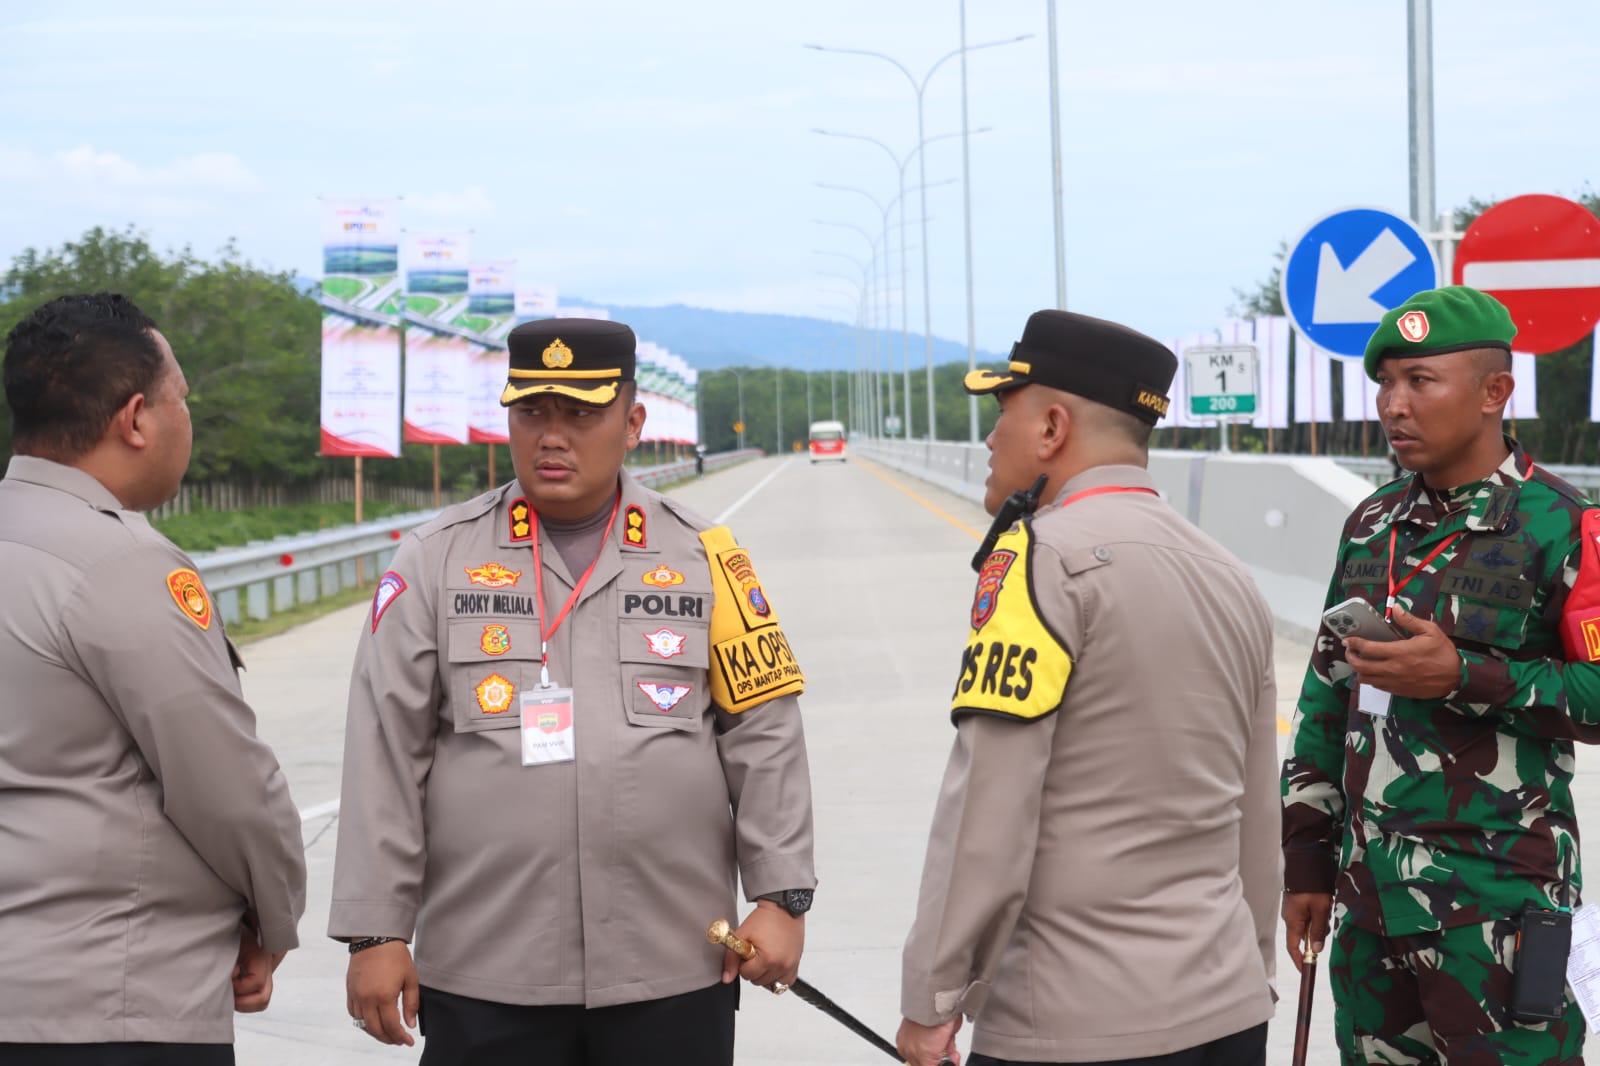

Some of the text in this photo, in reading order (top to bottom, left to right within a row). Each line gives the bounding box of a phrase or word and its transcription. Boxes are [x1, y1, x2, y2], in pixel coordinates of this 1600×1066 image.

[1209, 354, 1233, 367] KM
[1215, 370, 1226, 393] 1
[1209, 397, 1237, 411] 200
[1344, 563, 1388, 579] SLAMET
[1452, 575, 1521, 600] TNI AD
[454, 593, 534, 616] CHOKY MELIALA
[624, 594, 703, 618] POLRI
[724, 640, 760, 682] KA
[736, 679, 753, 694] OPS
[753, 669, 782, 688] MANTAP
